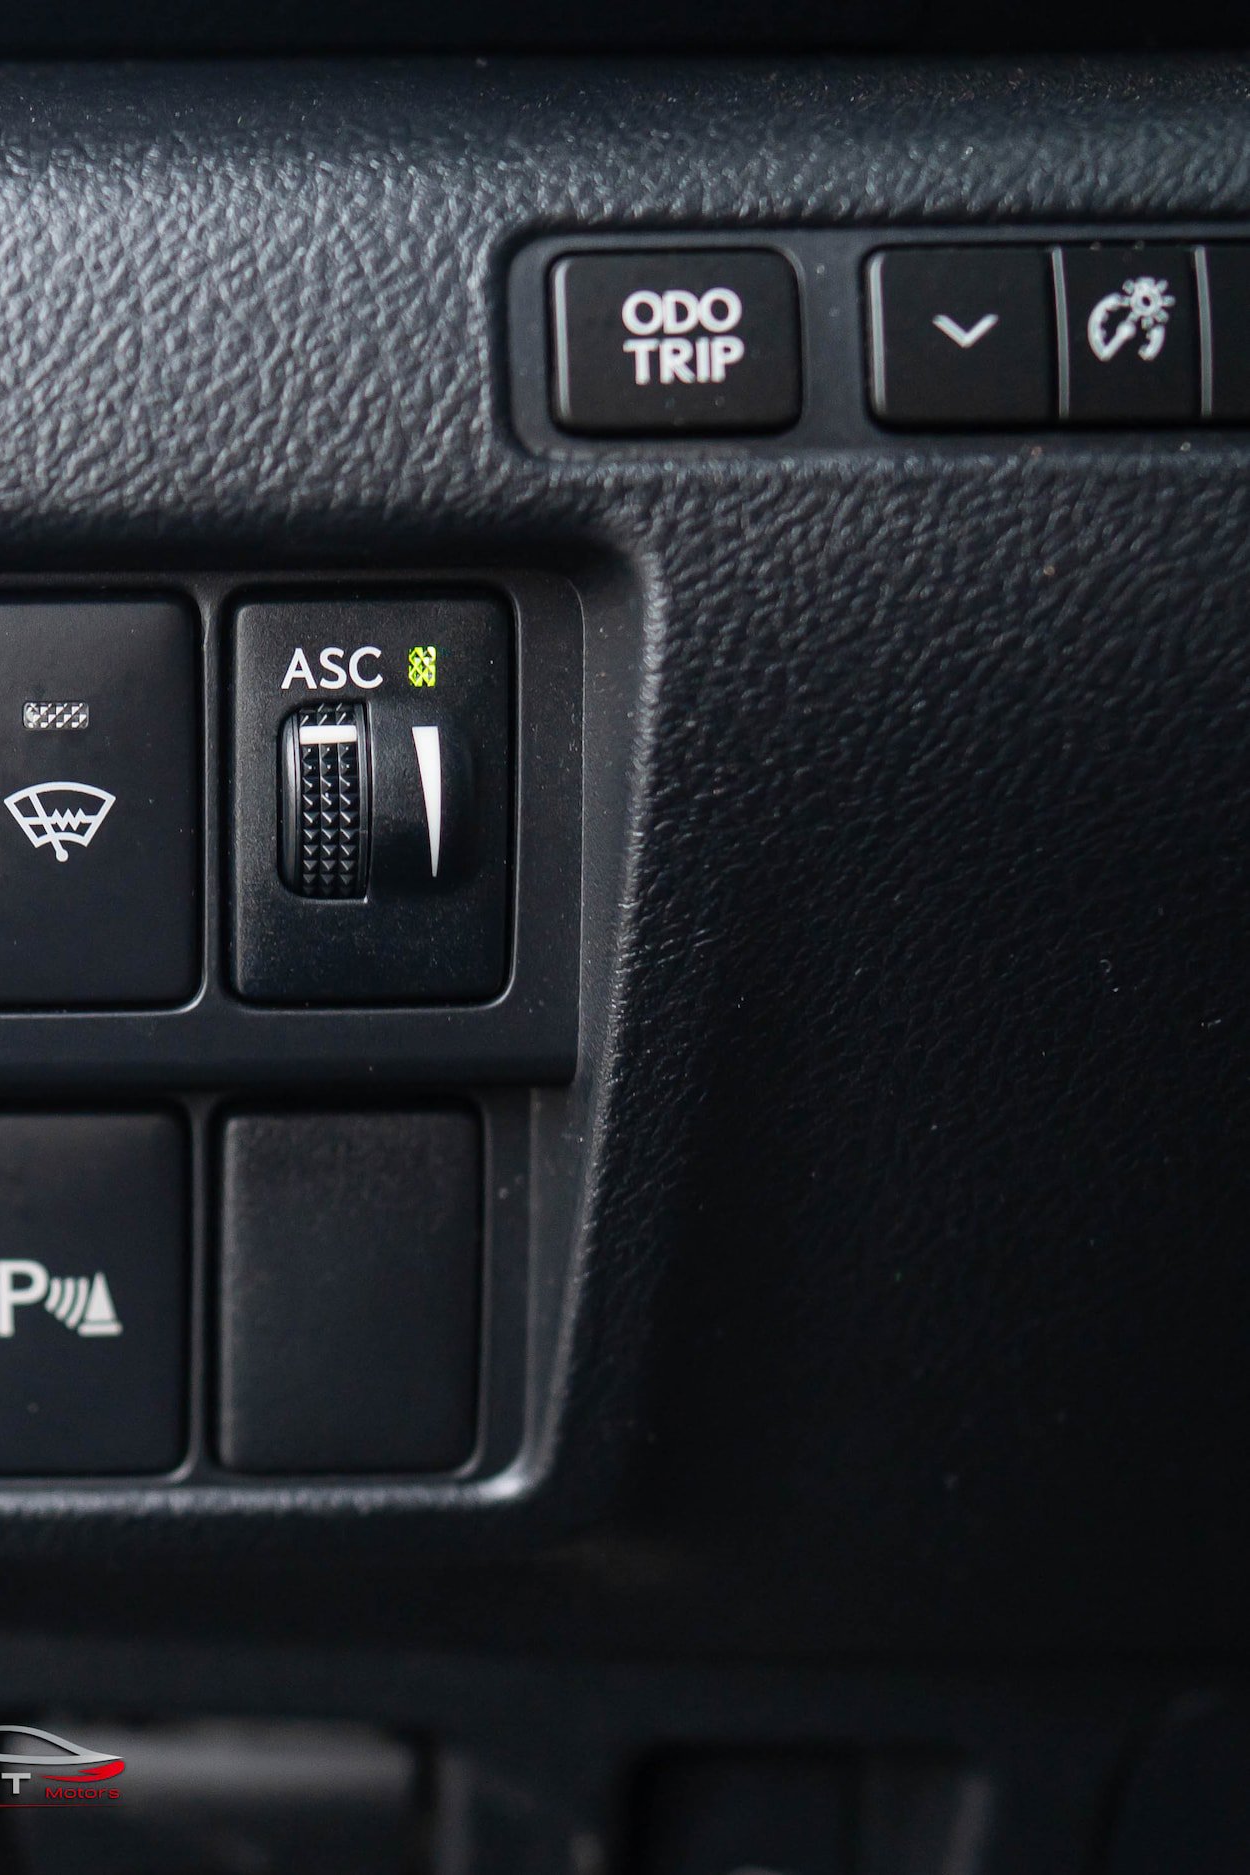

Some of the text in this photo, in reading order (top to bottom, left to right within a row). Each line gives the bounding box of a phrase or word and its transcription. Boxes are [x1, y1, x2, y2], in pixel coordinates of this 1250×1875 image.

[622, 287, 742, 336] ODO
[623, 336, 744, 385] TRIP
[281, 646, 383, 690] ASC
